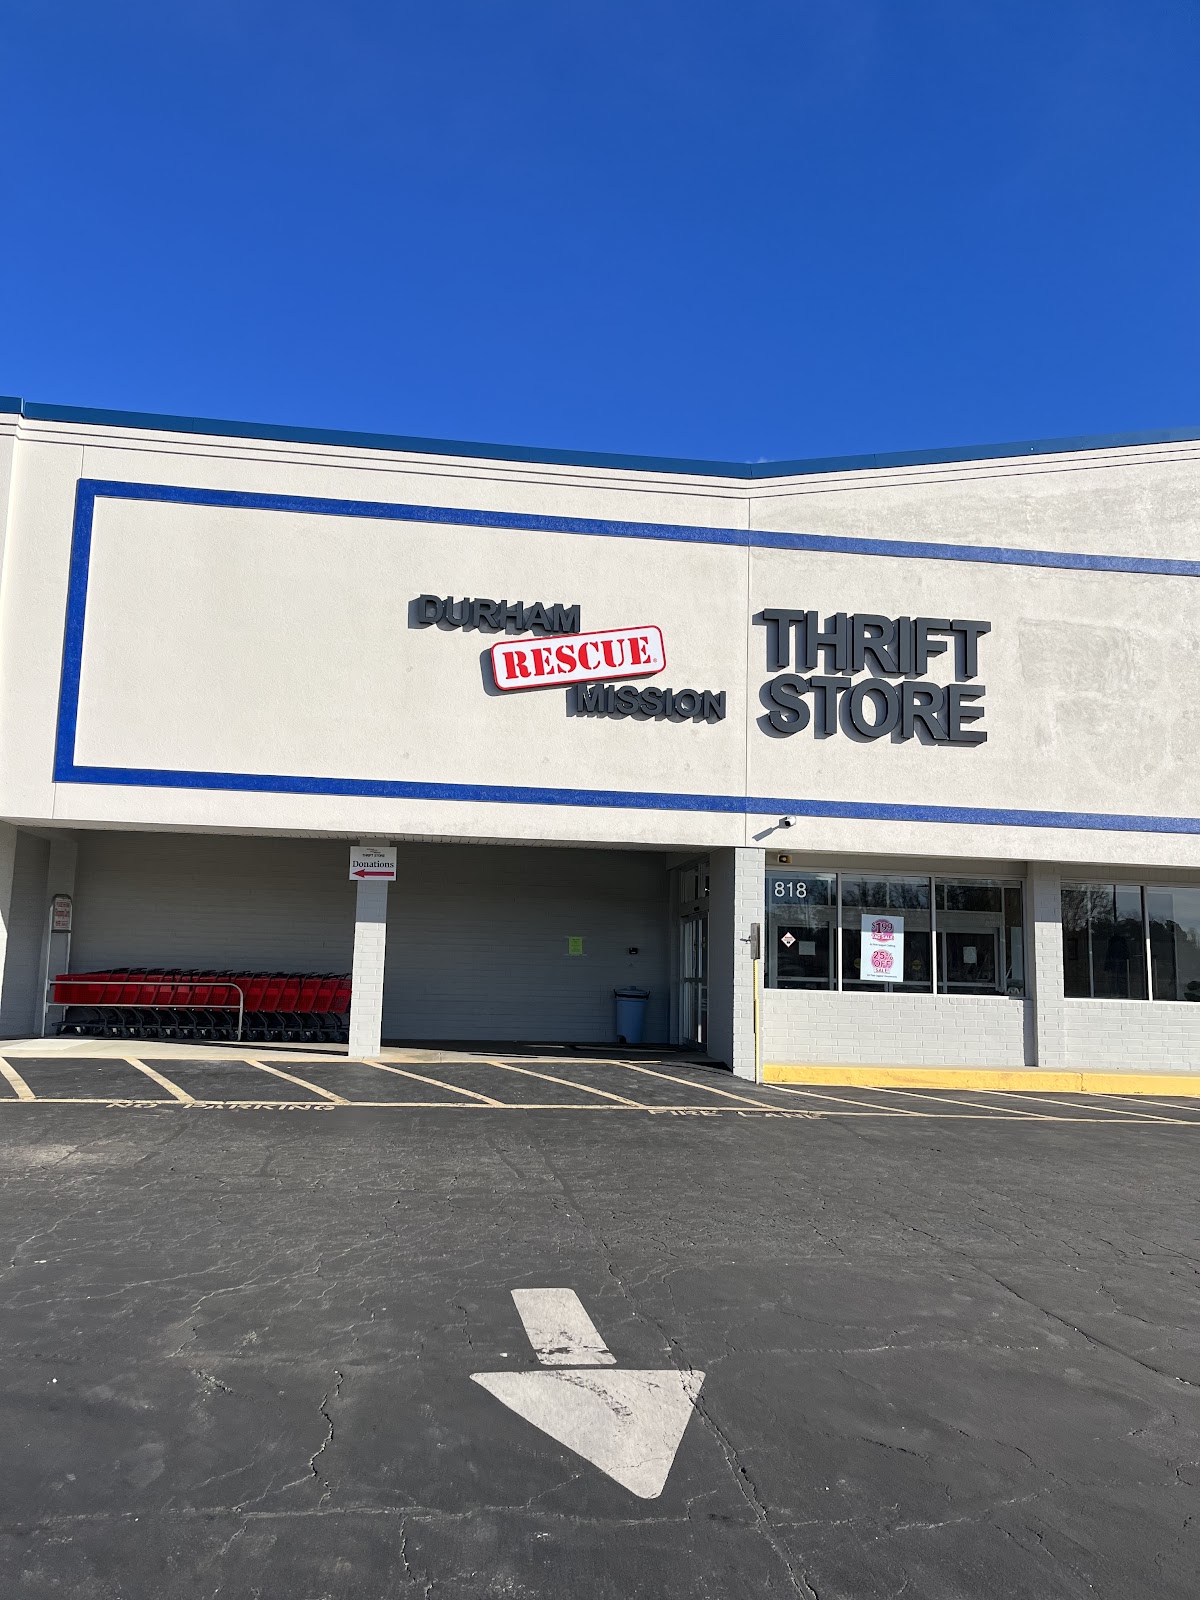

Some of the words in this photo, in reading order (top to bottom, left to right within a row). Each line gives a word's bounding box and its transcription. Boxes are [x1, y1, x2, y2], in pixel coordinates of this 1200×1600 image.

[414, 594, 581, 634] DURHAM
[758, 608, 991, 679] THRIFT
[502, 636, 653, 680] RESCUE
[572, 683, 727, 720] MISSION
[763, 673, 988, 744] STORE
[352, 860, 395, 868] Donations
[774, 881, 807, 898] 818
[873, 950, 894, 960] 25%
[874, 959, 892, 968] OFF
[183, 1103, 336, 1111] PARKING
[648, 1109, 723, 1117] FIRE
